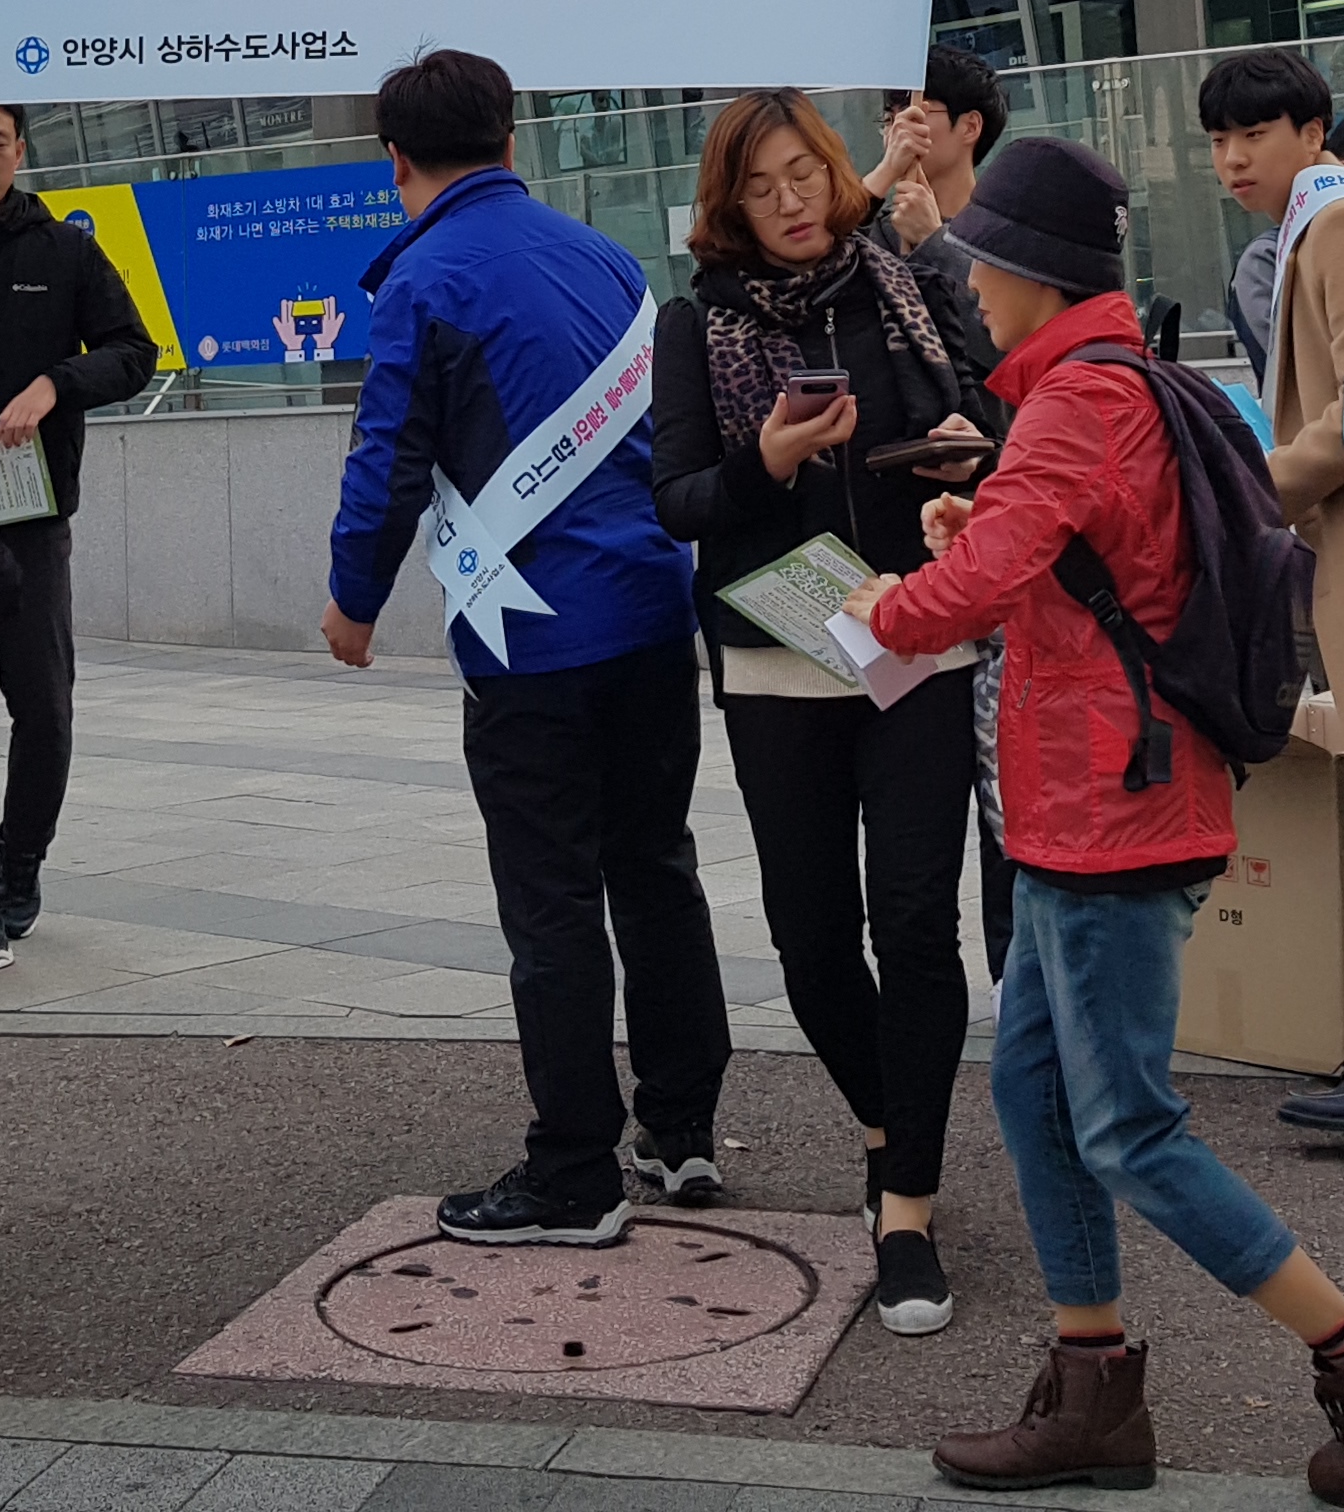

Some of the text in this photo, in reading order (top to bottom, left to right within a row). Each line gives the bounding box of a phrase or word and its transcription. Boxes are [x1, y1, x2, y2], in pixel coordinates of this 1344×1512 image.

[62, 31, 359, 66] 안양시 상하수도사업소
[207, 201, 257, 219] 화재초기
[262, 197, 300, 215] 소방차
[306, 194, 323, 210] 1대
[329, 191, 354, 208] 효과
[196, 223, 233, 242] 화재가
[238, 221, 263, 238] 나면
[268, 218, 320, 237] 알려주는
[512, 401, 610, 500] 절약합시다
[1219, 908, 1243, 925] D형
